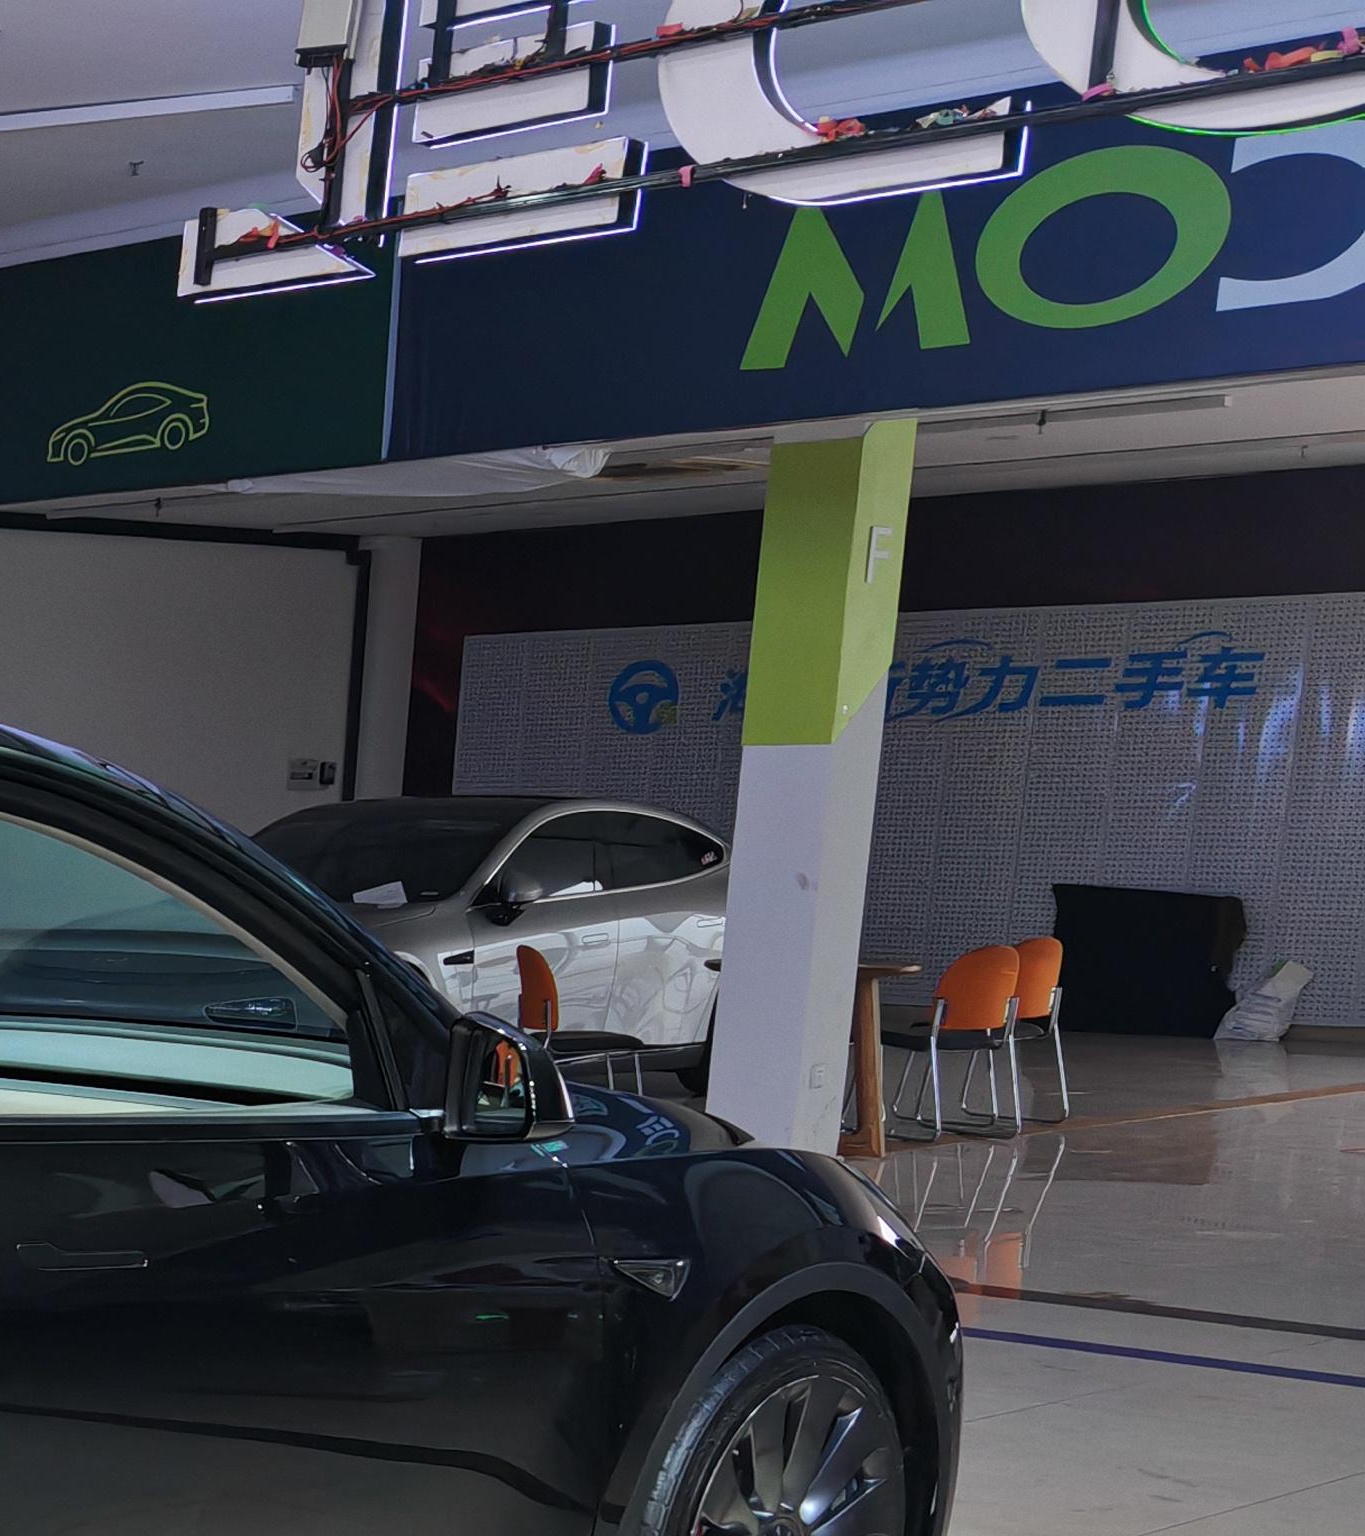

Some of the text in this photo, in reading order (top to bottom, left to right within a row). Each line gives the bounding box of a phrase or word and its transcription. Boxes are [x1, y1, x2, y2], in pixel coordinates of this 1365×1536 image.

[865, 526, 894, 584] F
[883, 643, 1266, 723] 势力二手车
